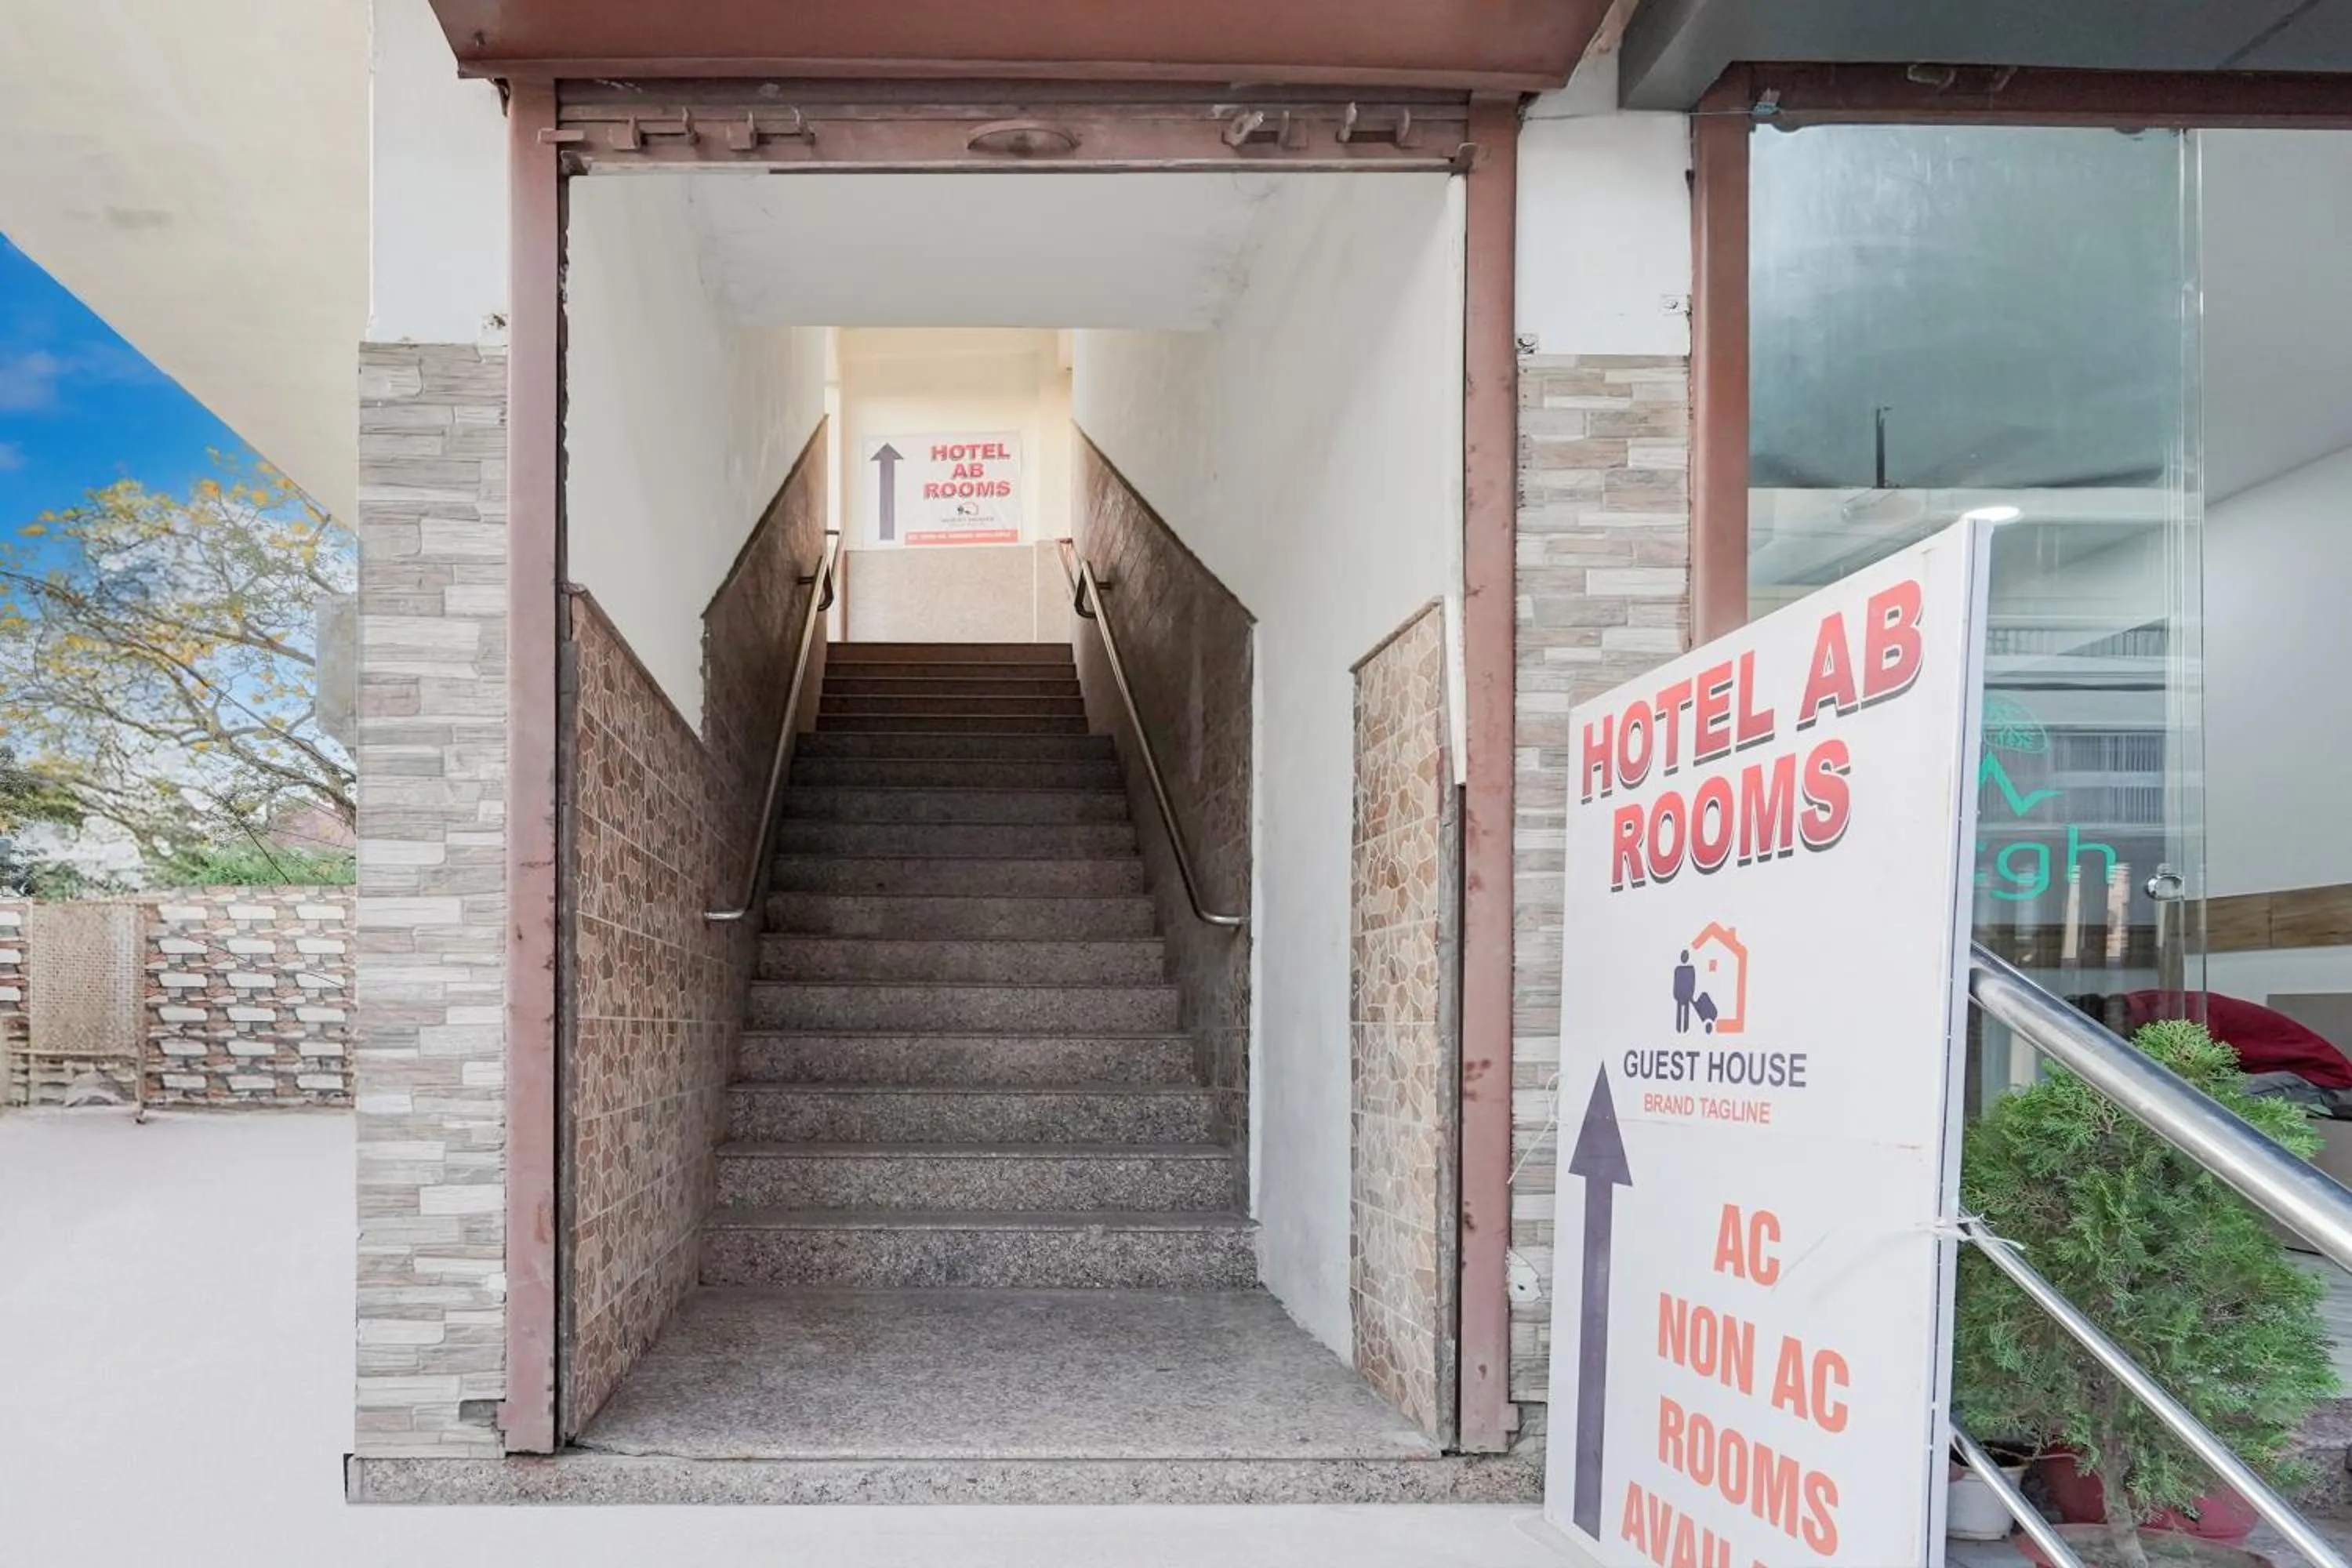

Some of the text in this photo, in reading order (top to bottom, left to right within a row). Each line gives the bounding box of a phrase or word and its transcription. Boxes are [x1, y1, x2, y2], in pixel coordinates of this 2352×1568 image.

[931, 443, 1011, 461] HOTEL
[952, 463, 984, 479] AB
[923, 481, 1011, 499] ROOMS
[1581, 579, 1924, 804] HOTEL AB
[1610, 739, 1851, 892] ROOMS
[1624, 1050, 1807, 1087] GUEST HOUSE
[1644, 1094, 1771, 1123] BRAND TAGLINE
[1714, 1204, 1780, 1286] AC
[1658, 1292, 1849, 1433] NON AC
[1658, 1395, 1838, 1556] ROOMS
